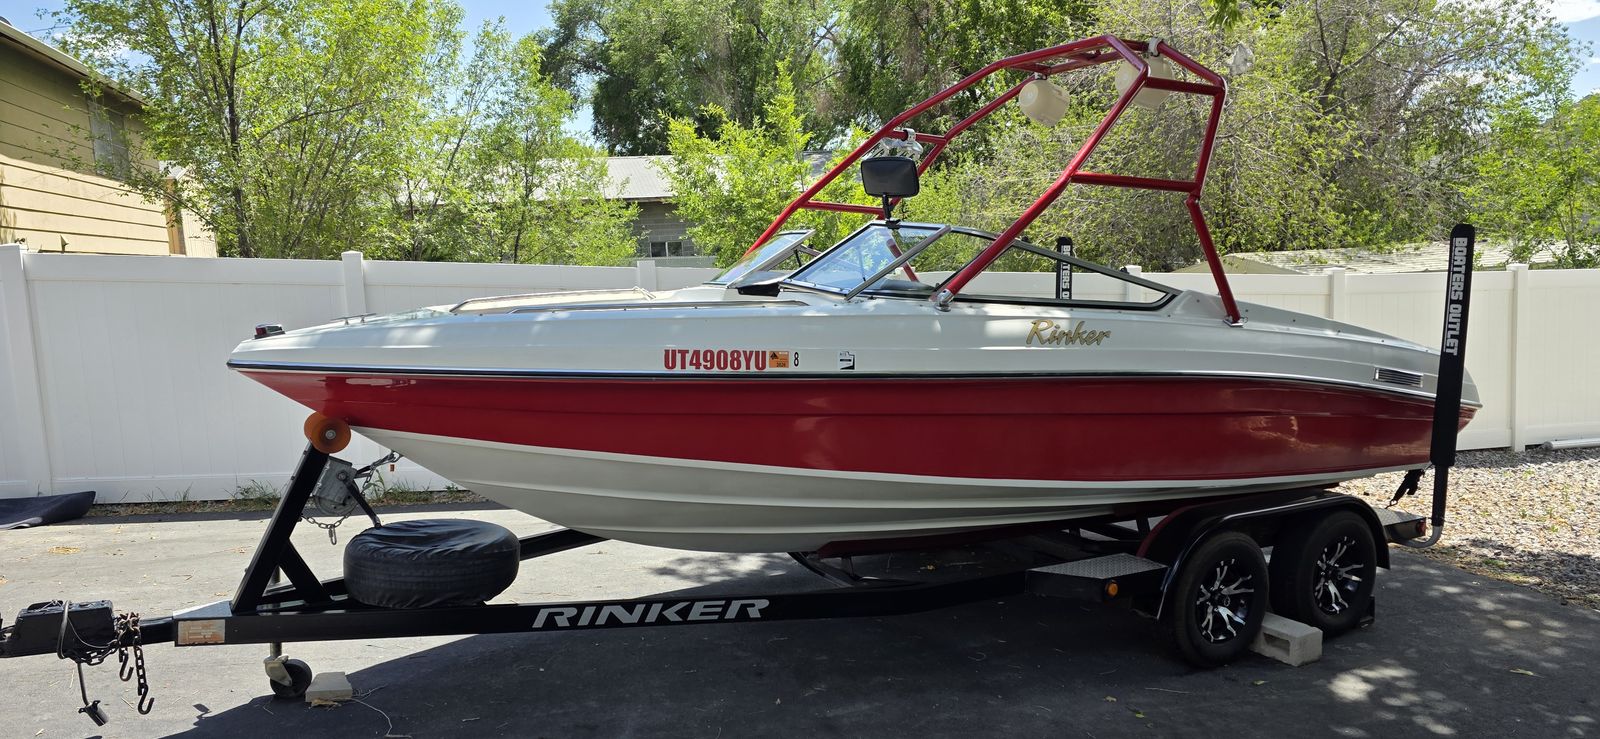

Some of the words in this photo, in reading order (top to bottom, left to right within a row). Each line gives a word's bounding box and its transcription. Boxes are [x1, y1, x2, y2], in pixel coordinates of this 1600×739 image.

[1062, 245, 1070, 289] BOTERS
[1451, 237, 1468, 301] BOATERS
[1025, 319, 1111, 346] Rinker
[1446, 303, 1462, 356] OUTLET
[664, 349, 767, 371] UT4908YU
[793, 351, 800, 367] 8
[531, 598, 770, 629] RINKER
